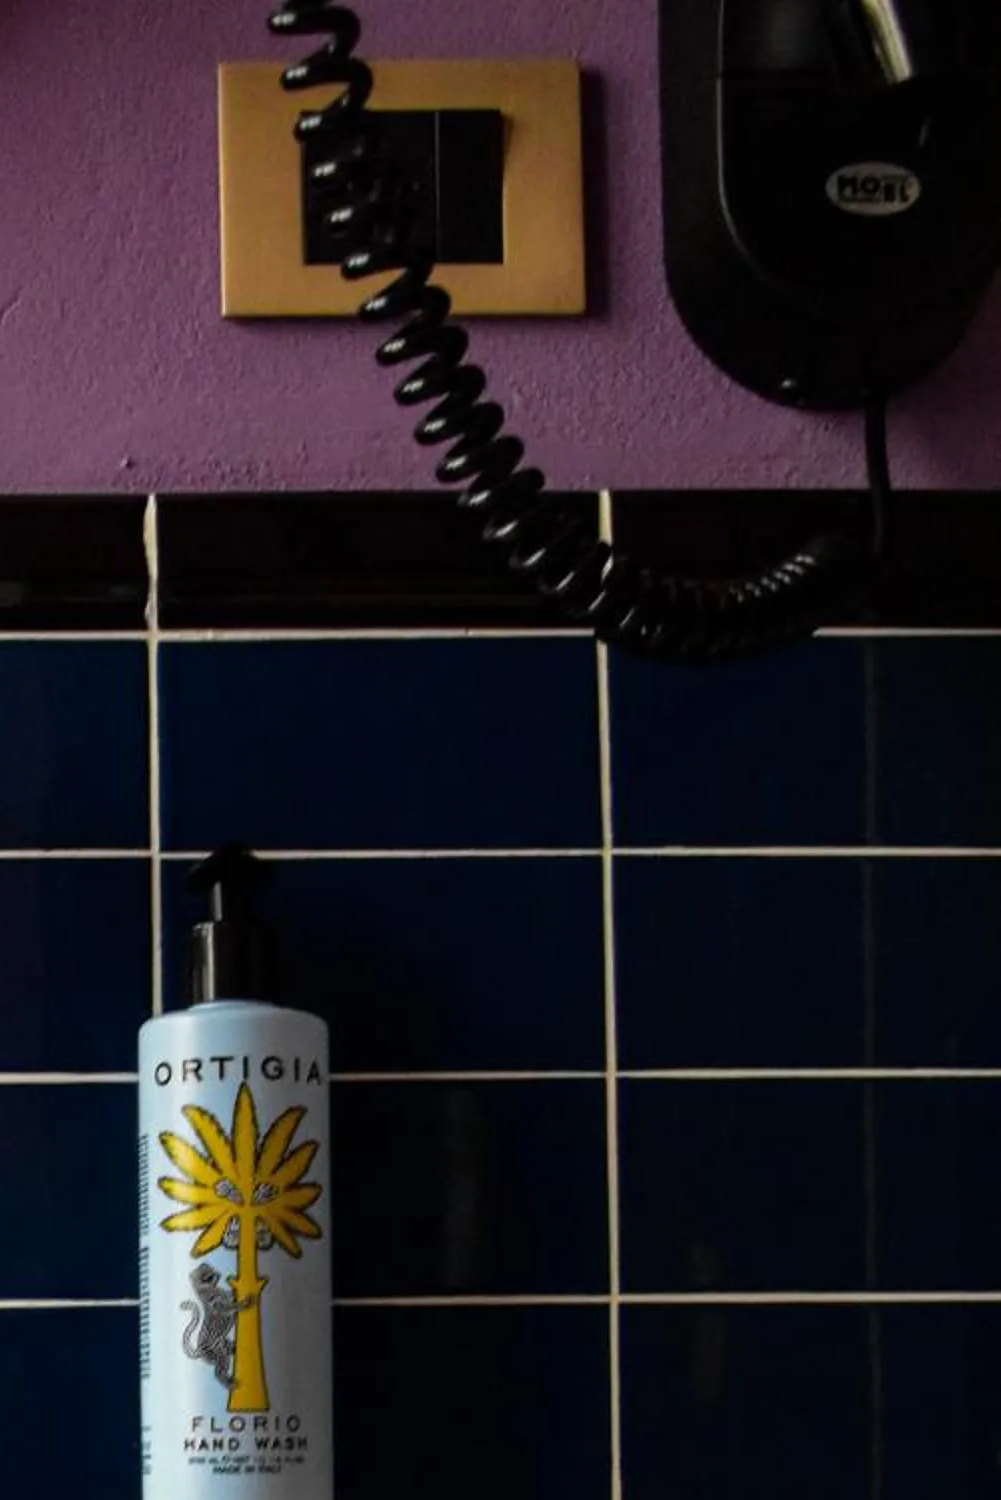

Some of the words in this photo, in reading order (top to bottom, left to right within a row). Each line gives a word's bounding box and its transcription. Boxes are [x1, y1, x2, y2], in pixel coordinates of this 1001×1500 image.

[154, 1055, 322, 1087] ORTIGIA
[191, 1414, 301, 1433] FLORIO
[183, 1436, 241, 1451] HAND
[254, 1436, 308, 1451] WASH
